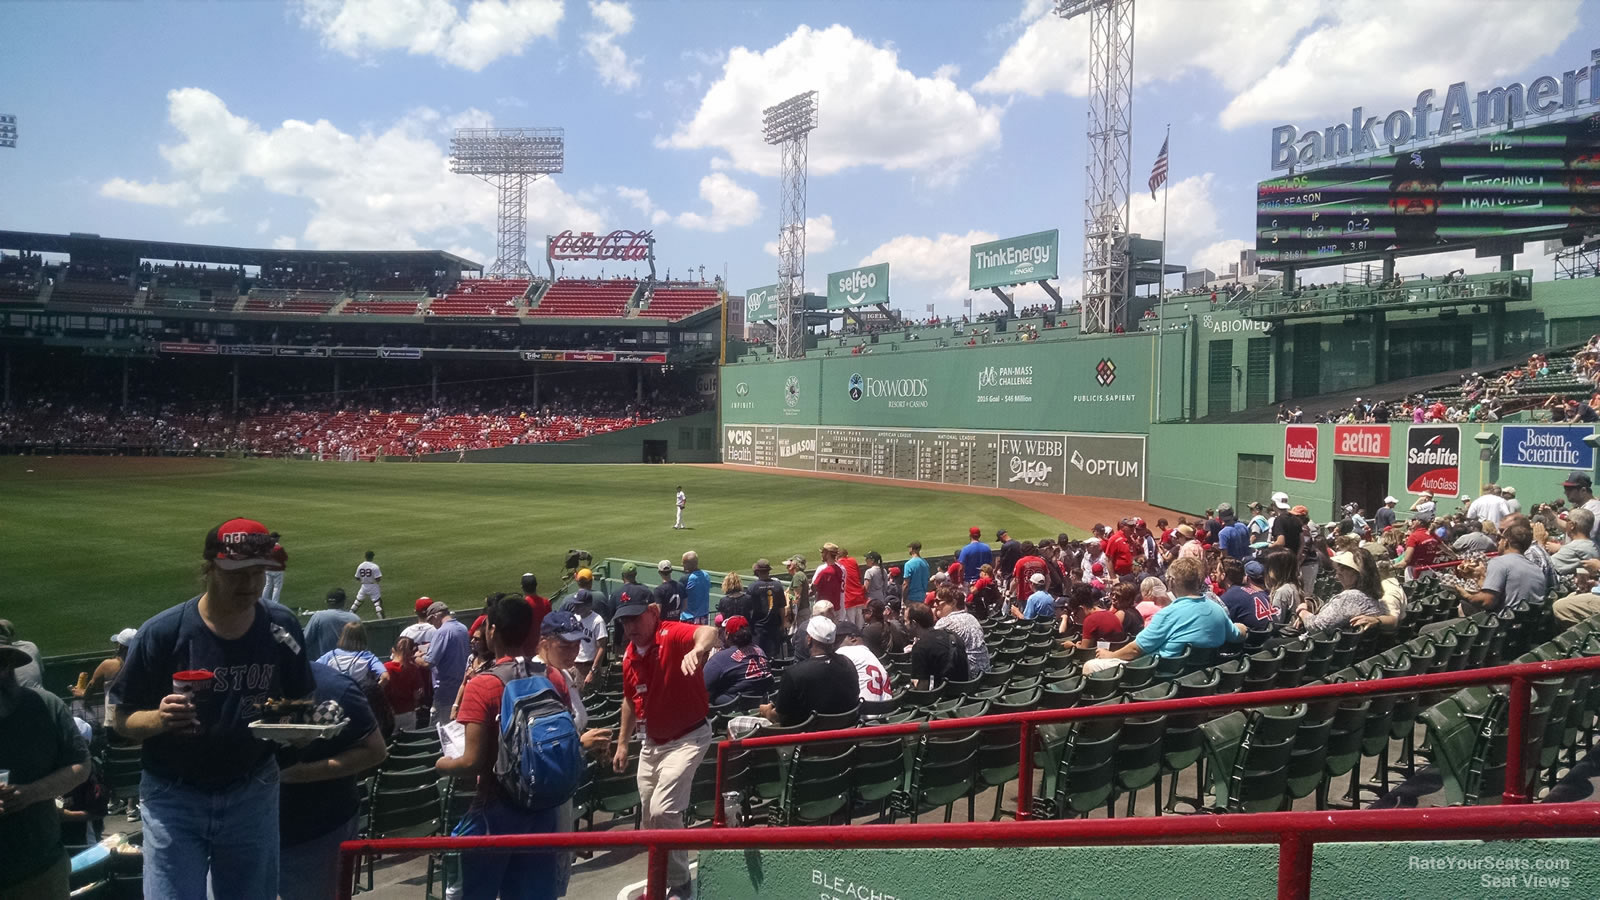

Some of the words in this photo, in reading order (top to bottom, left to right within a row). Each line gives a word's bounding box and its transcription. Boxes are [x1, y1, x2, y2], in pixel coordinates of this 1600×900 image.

[1271, 106, 1382, 171] Bank
[1383, 88, 1436, 147] of
[1260, 175, 1309, 195] SHIELDS
[1284, 191, 1322, 207] SEASON
[549, 230, 653, 261] Coca-Cola
[1272, 233, 1279, 244] 3
[975, 245, 1050, 270] ThinkEnergy
[1213, 319, 1273, 333] ABIOMED
[1000, 366, 1033, 376] PAN-MASS
[866, 377, 928, 398] FOXWOODS
[1000, 376, 1033, 386] CHALLENGE
[735, 430, 752, 445] CVS
[1341, 430, 1381, 454] aetna
[1526, 428, 1565, 447] Boston
[728, 446, 752, 461] Health
[1001, 440, 1022, 455] F.W.
[1025, 440, 1063, 457] WEBB
[1408, 447, 1458, 466] Safelite
[1517, 441, 1580, 465] Scientific
[1086, 459, 1138, 477] OPTUM
[1421, 476, 1457, 491] AutoGlass
